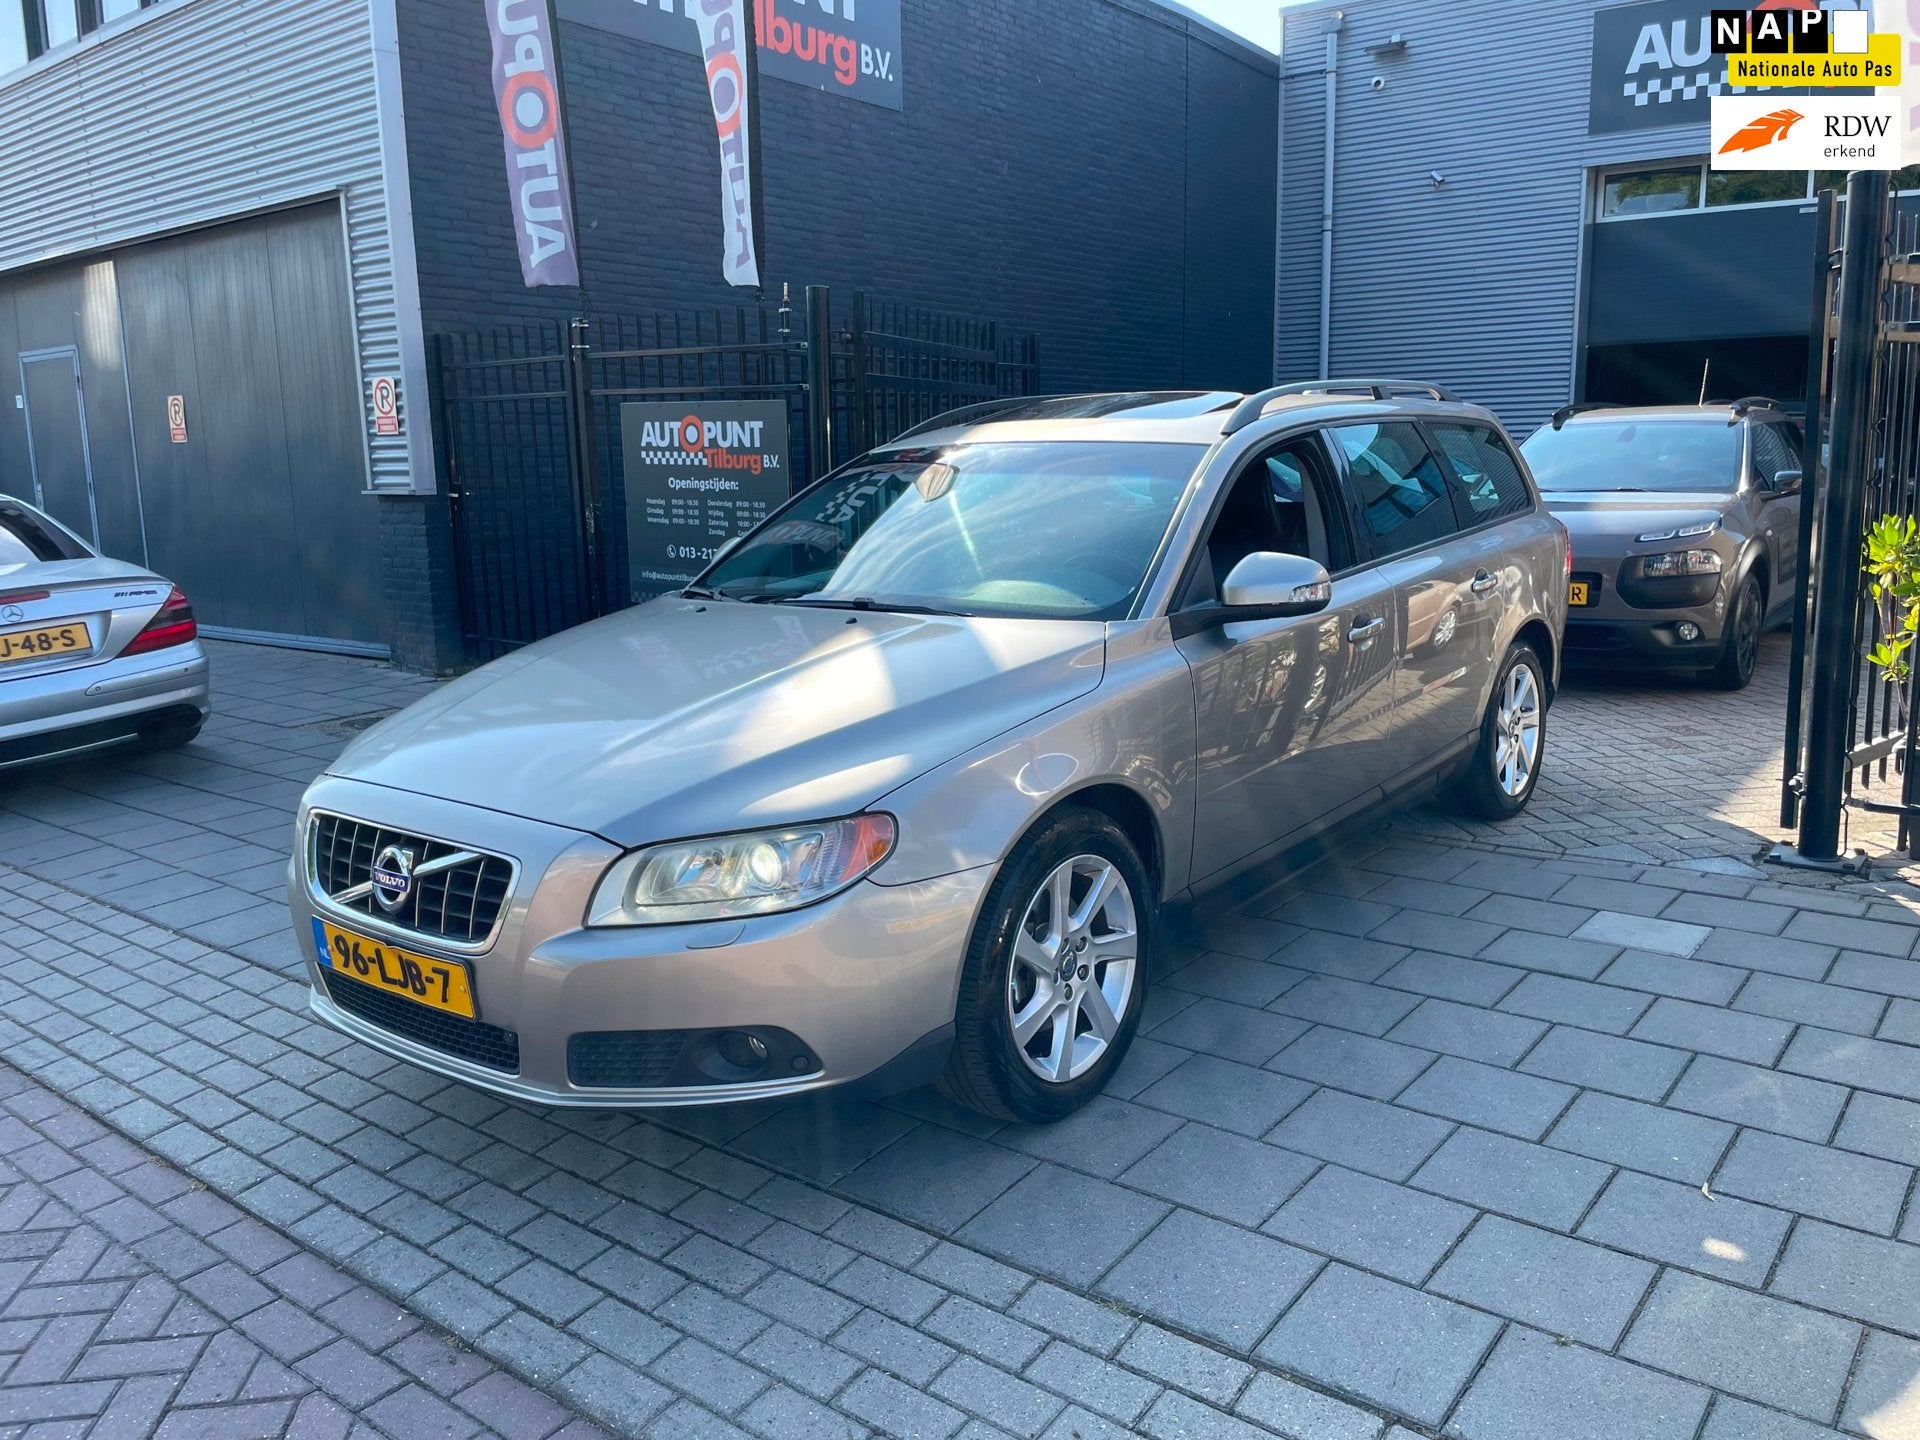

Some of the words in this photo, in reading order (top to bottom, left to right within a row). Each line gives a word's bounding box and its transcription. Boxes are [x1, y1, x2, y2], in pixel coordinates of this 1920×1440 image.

[860, 43, 893, 82] B.V.
[641, 414, 763, 453] AUTOPUNT
[705, 448, 761, 475] Tilburg
[763, 454, 780, 468] B.V.
[668, 476, 739, 495] Openingstijden:
[374, 871, 406, 888] VOLVO
[334, 934, 450, 1004] 96-LJB-7
